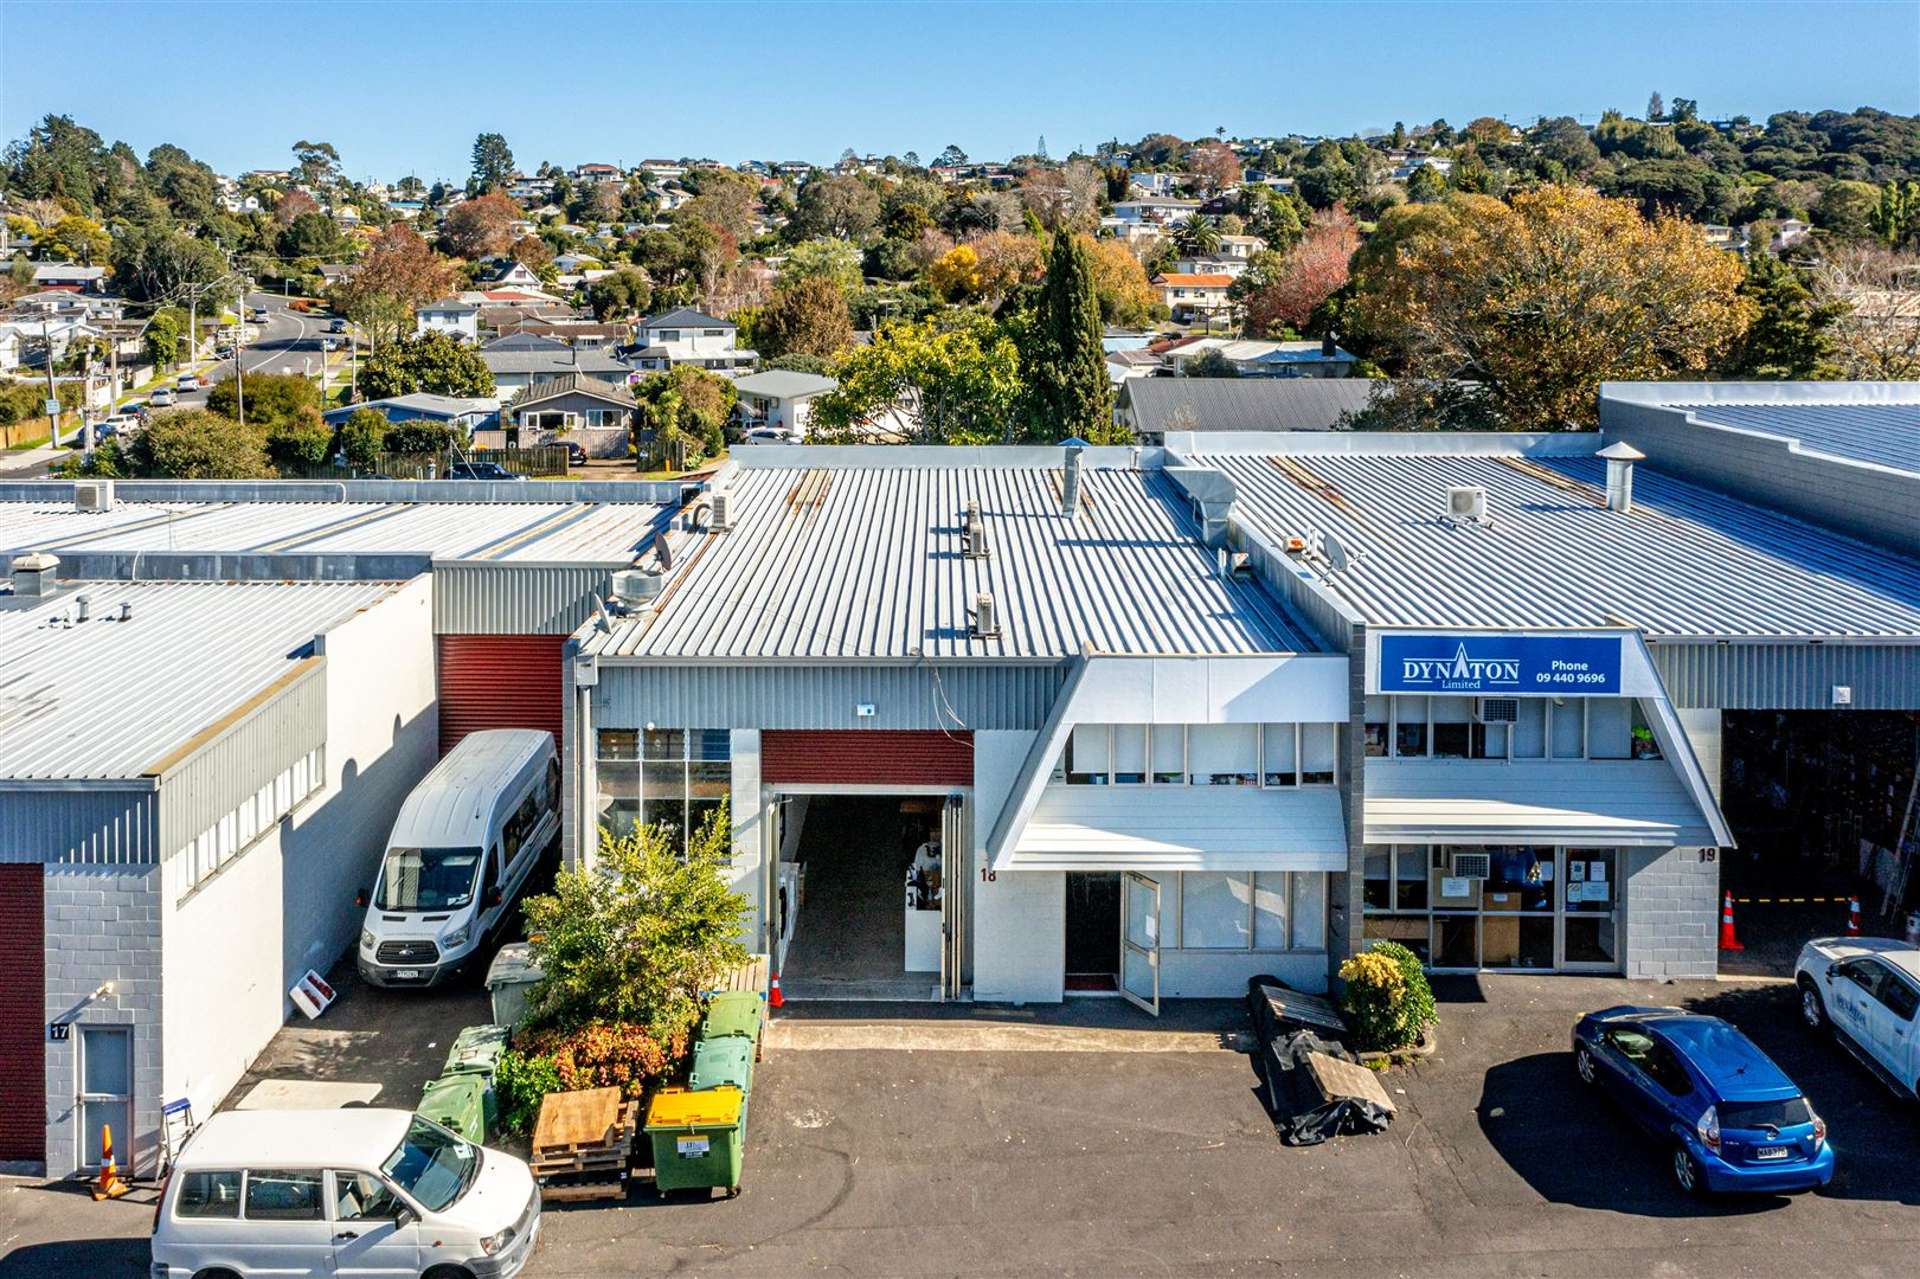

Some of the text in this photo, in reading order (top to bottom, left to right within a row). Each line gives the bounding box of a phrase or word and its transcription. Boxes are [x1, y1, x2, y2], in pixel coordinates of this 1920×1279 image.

[1402, 650, 1520, 680] DYNATON
[1551, 660, 1589, 671] Phone
[1536, 673, 1606, 683] 09 440 9696
[1442, 680, 1481, 689] Limited
[1698, 848, 1715, 862] 19
[980, 868, 996, 881] 18
[52, 1026, 68, 1038] 17
